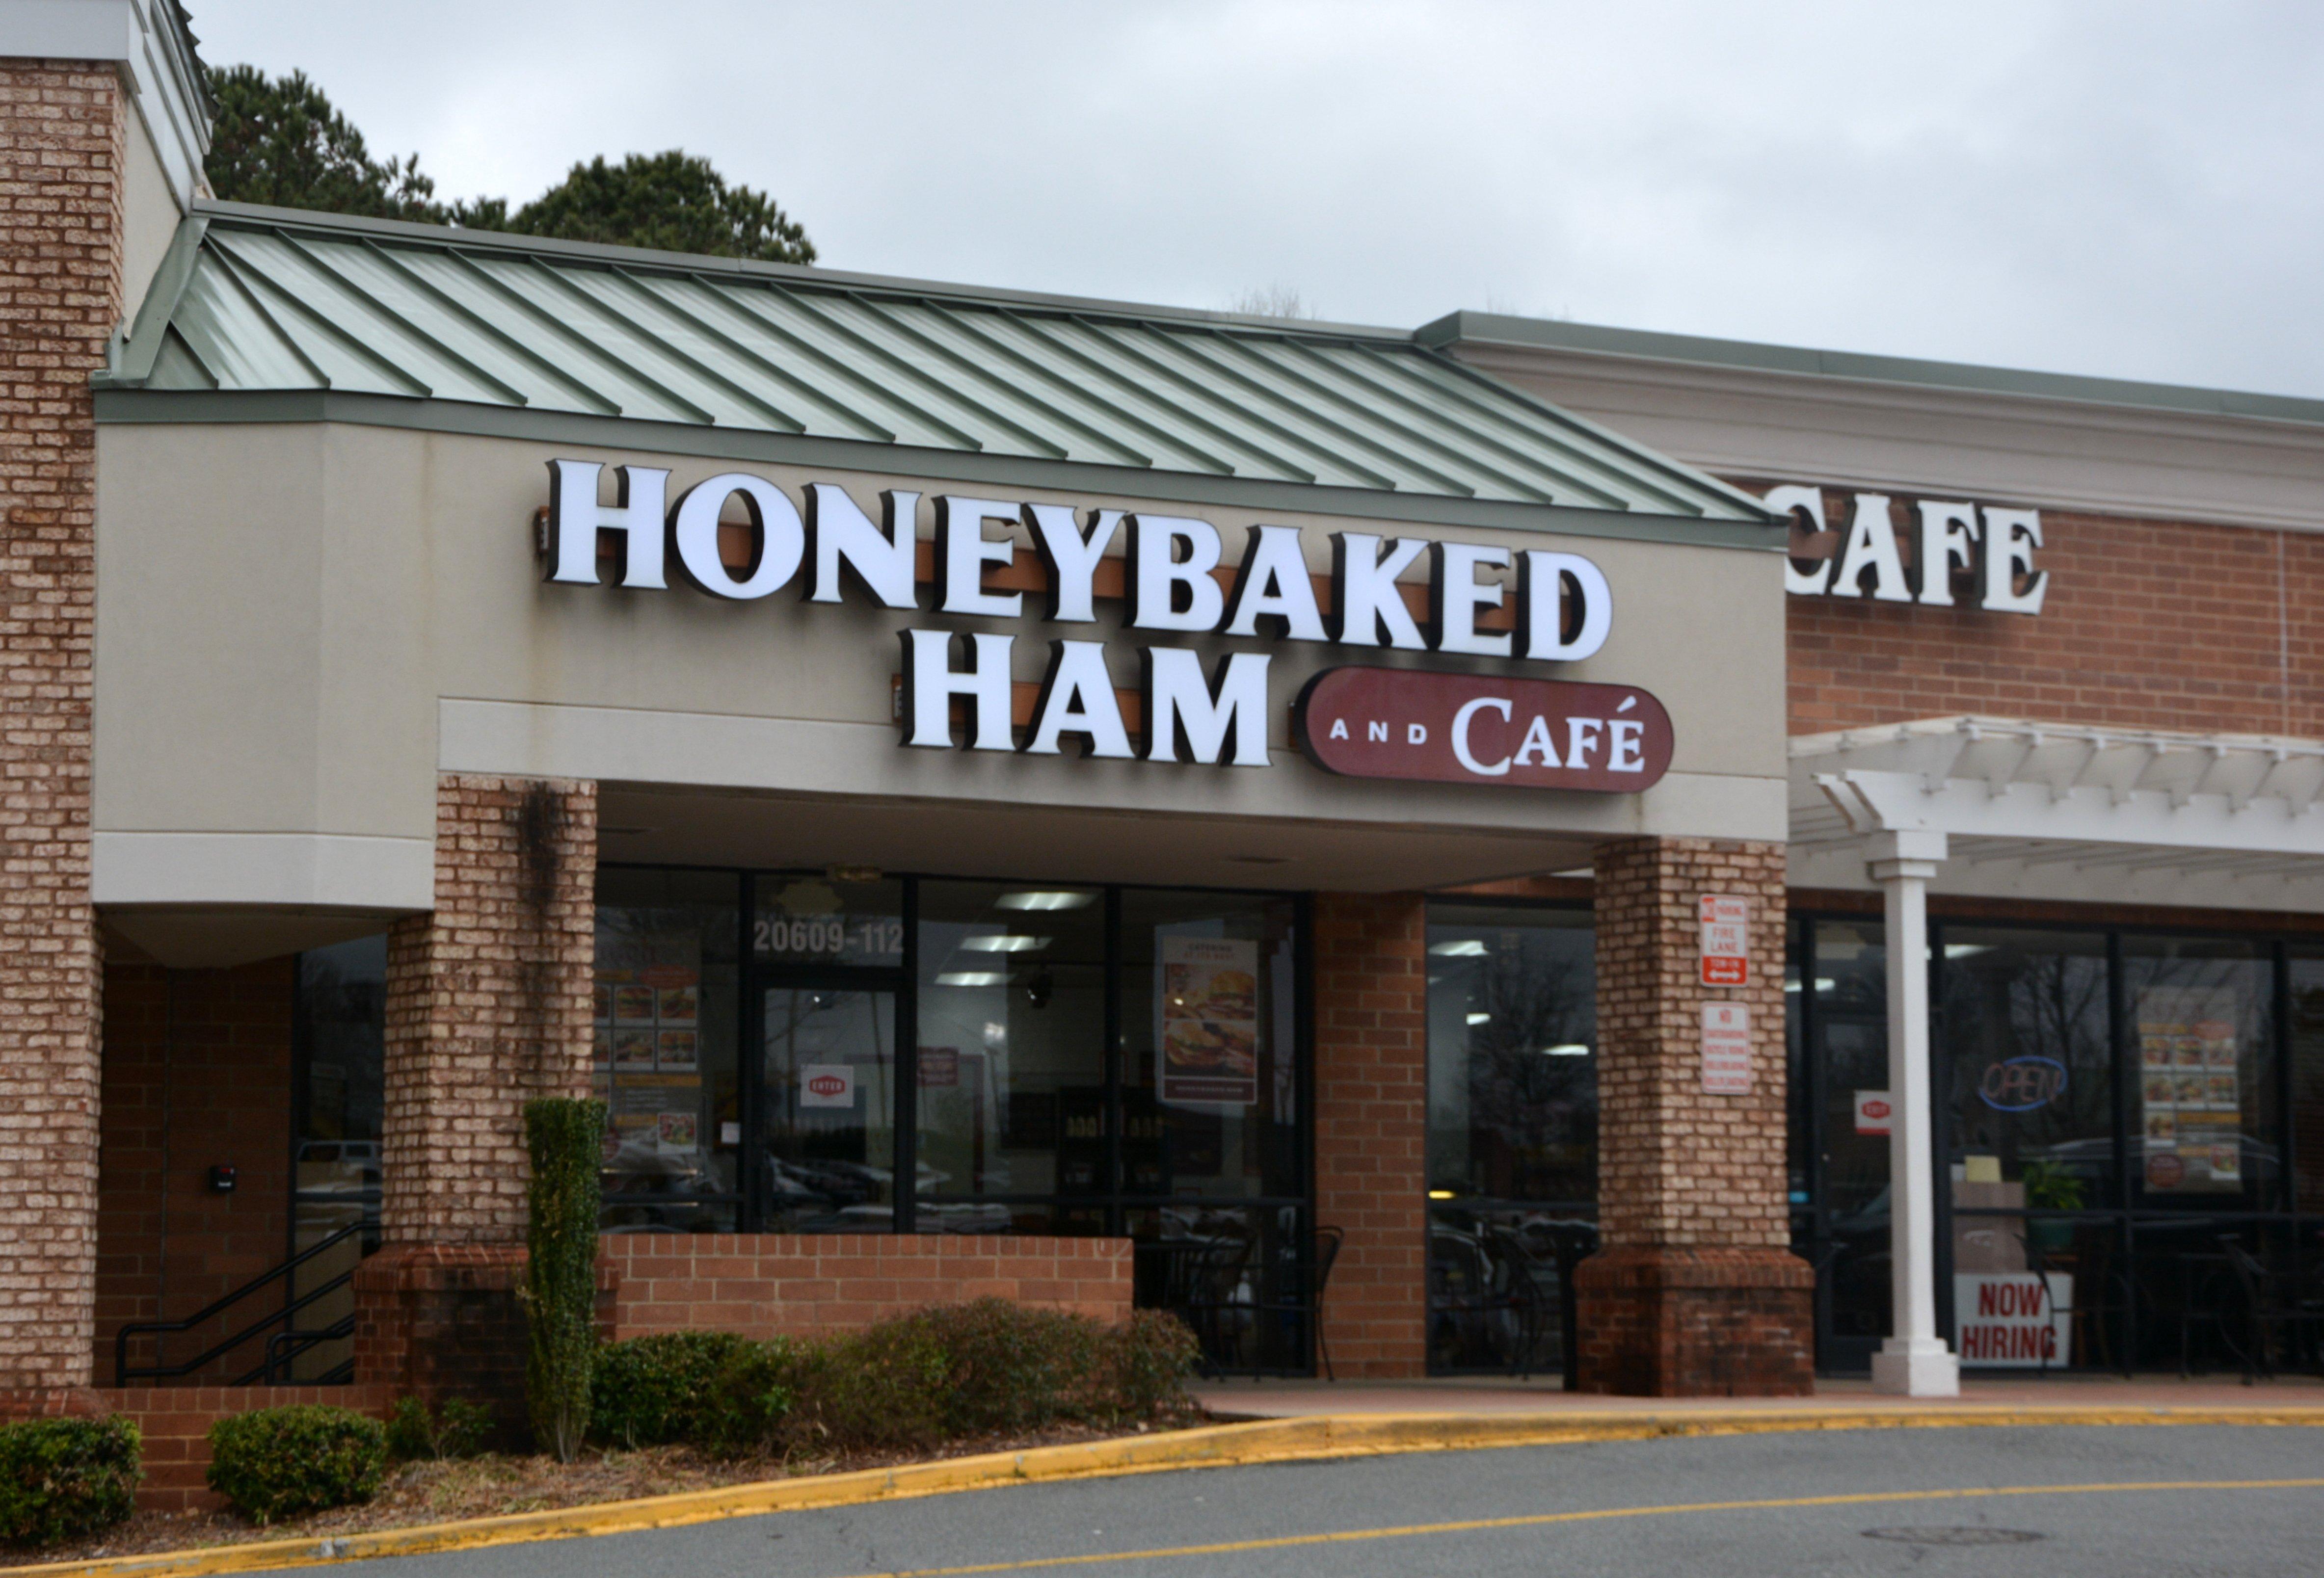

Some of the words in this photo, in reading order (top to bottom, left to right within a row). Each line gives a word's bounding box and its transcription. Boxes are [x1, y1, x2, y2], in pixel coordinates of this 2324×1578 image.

[547, 458, 1613, 661] HONEYBAKED
[1764, 485, 2049, 615] CAFE
[900, 628, 1273, 767] HAM
[1329, 718, 1427, 745] AND
[753, 920, 904, 953] 20609-112
[1710, 941, 1738, 953] LANE
[1712, 926, 1736, 939] FIRE
[812, 1080, 843, 1091] ENTER
[1983, 1062, 2061, 1104] OPEN
[1978, 1282, 2045, 1317] NOW
[1962, 1324, 2057, 1359] HIRING
